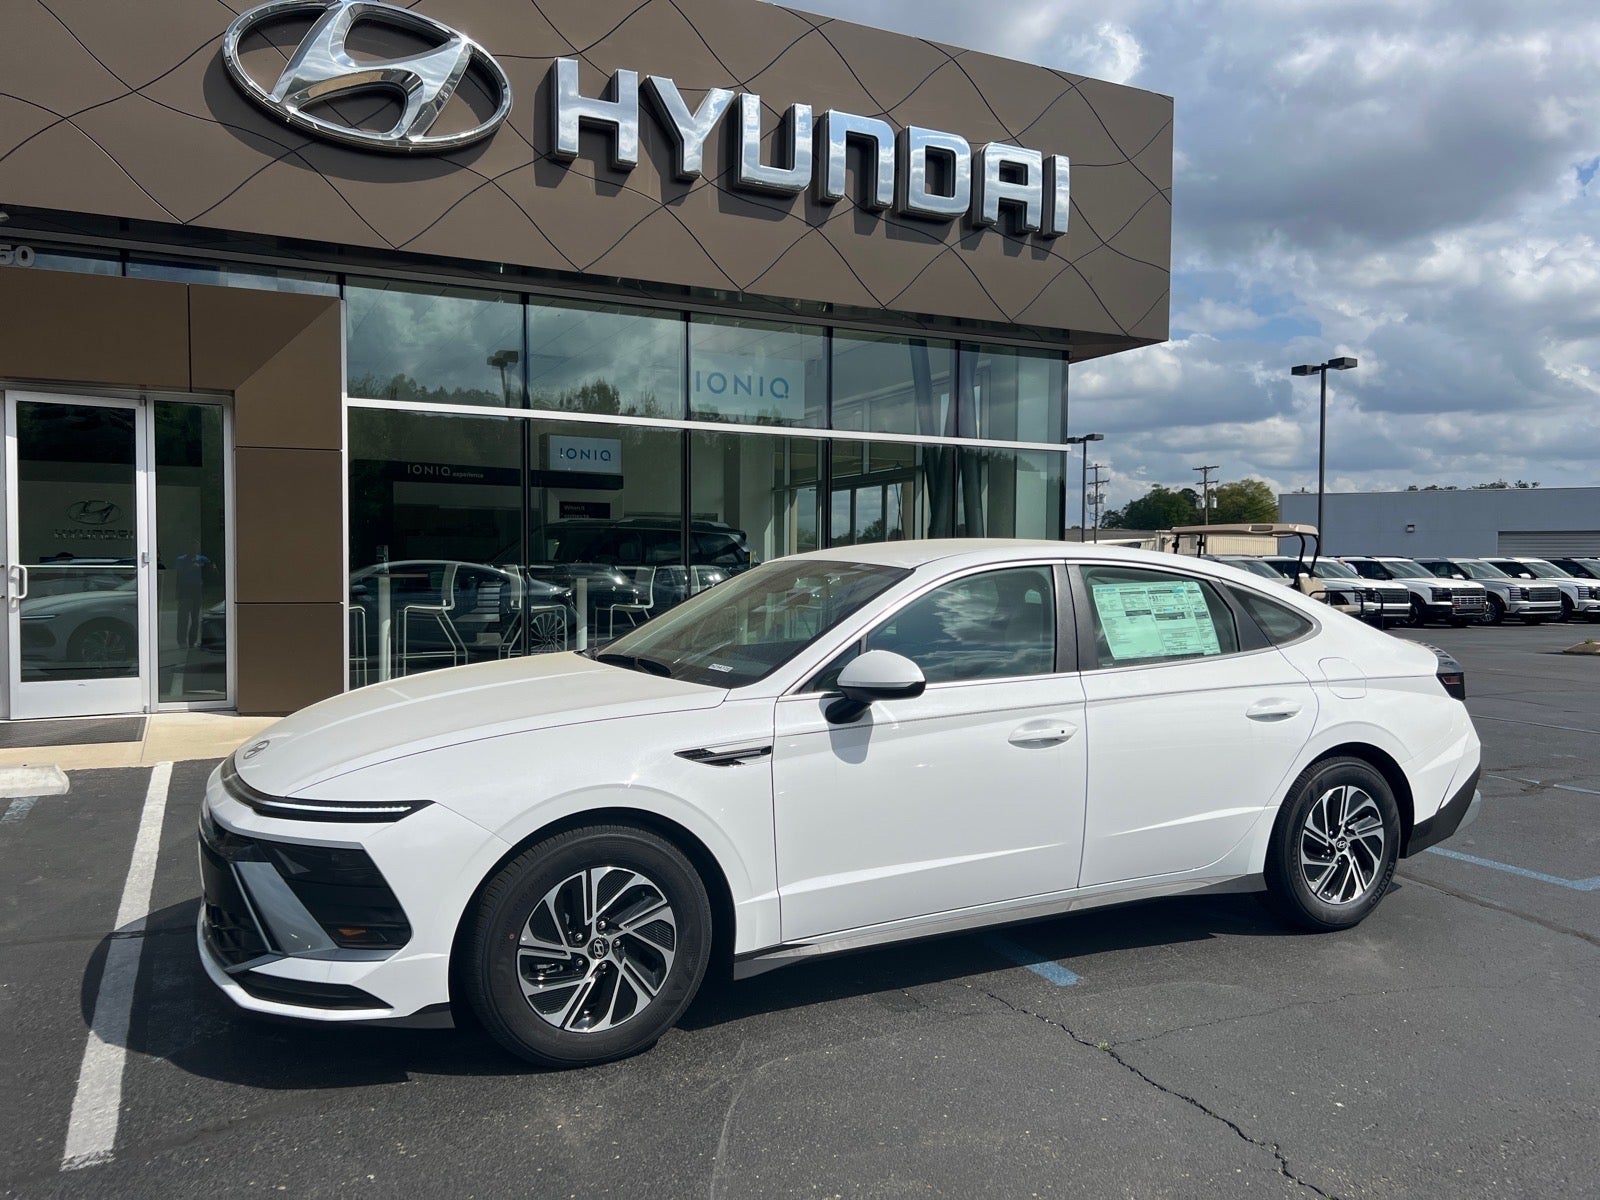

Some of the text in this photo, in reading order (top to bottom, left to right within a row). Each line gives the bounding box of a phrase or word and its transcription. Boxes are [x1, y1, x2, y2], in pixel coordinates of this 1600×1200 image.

[552, 57, 1070, 239] HYUNDAI
[695, 370, 789, 399] IONIQ
[560, 447, 611, 461] IONIQ
[407, 464, 451, 477] IONIQ
[1370, 861, 1395, 904] KUMHO
